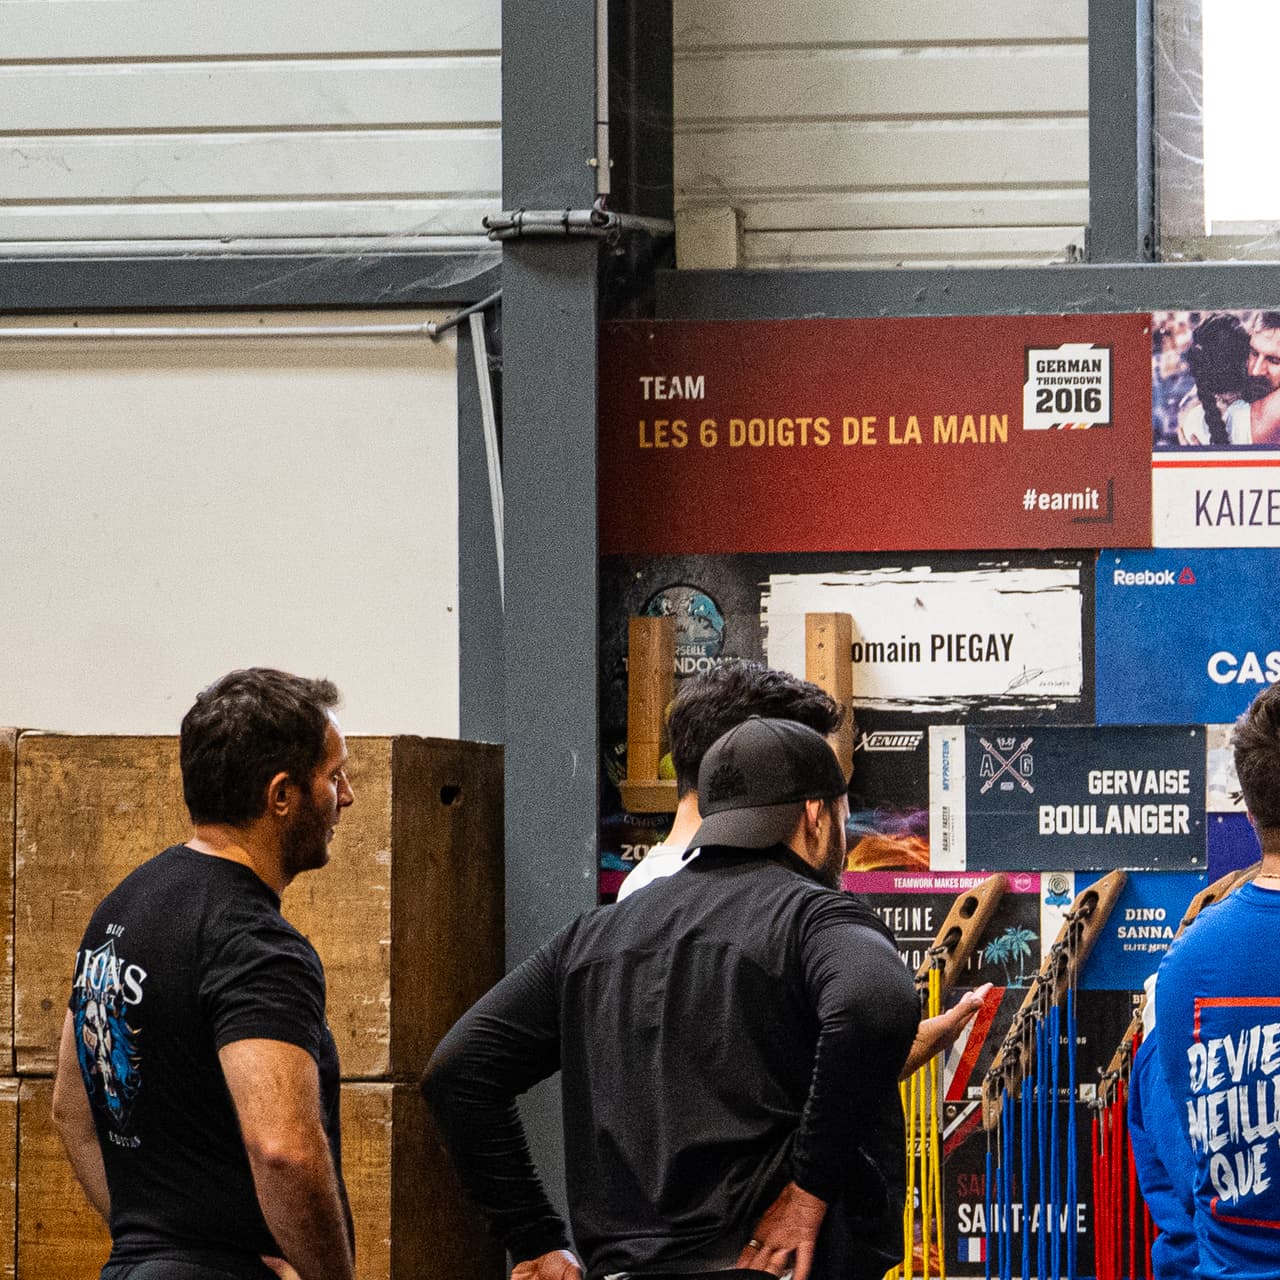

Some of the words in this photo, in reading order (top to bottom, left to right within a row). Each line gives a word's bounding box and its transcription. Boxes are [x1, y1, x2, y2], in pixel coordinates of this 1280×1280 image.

[1036, 358, 1102, 374] GERMAN
[640, 375, 705, 401] TEAM
[1036, 376, 1102, 386] THROWDOWN
[1035, 387, 1102, 414] 2016
[639, 419, 689, 449] LES
[699, 419, 718, 448] 6
[729, 416, 831, 447] DOIGTS
[842, 416, 877, 445] DE
[888, 415, 922, 445] LA
[933, 414, 1009, 444] MAIN
[1023, 485, 1100, 511] #earnit
[1113, 569, 1176, 586] Reebok
[851, 635, 922, 664] omain
[930, 633, 1015, 663] PIEGAY
[1088, 769, 1190, 795] GERVAISE
[1038, 804, 1191, 836] BOULANGER
[893, 877, 934, 889] TEAMWORK
[934, 877, 958, 889] MAKES
[1124, 908, 1167, 922] DINO
[1117, 925, 1175, 940] SANNA
[1209, 1142, 1272, 1206] QUE
